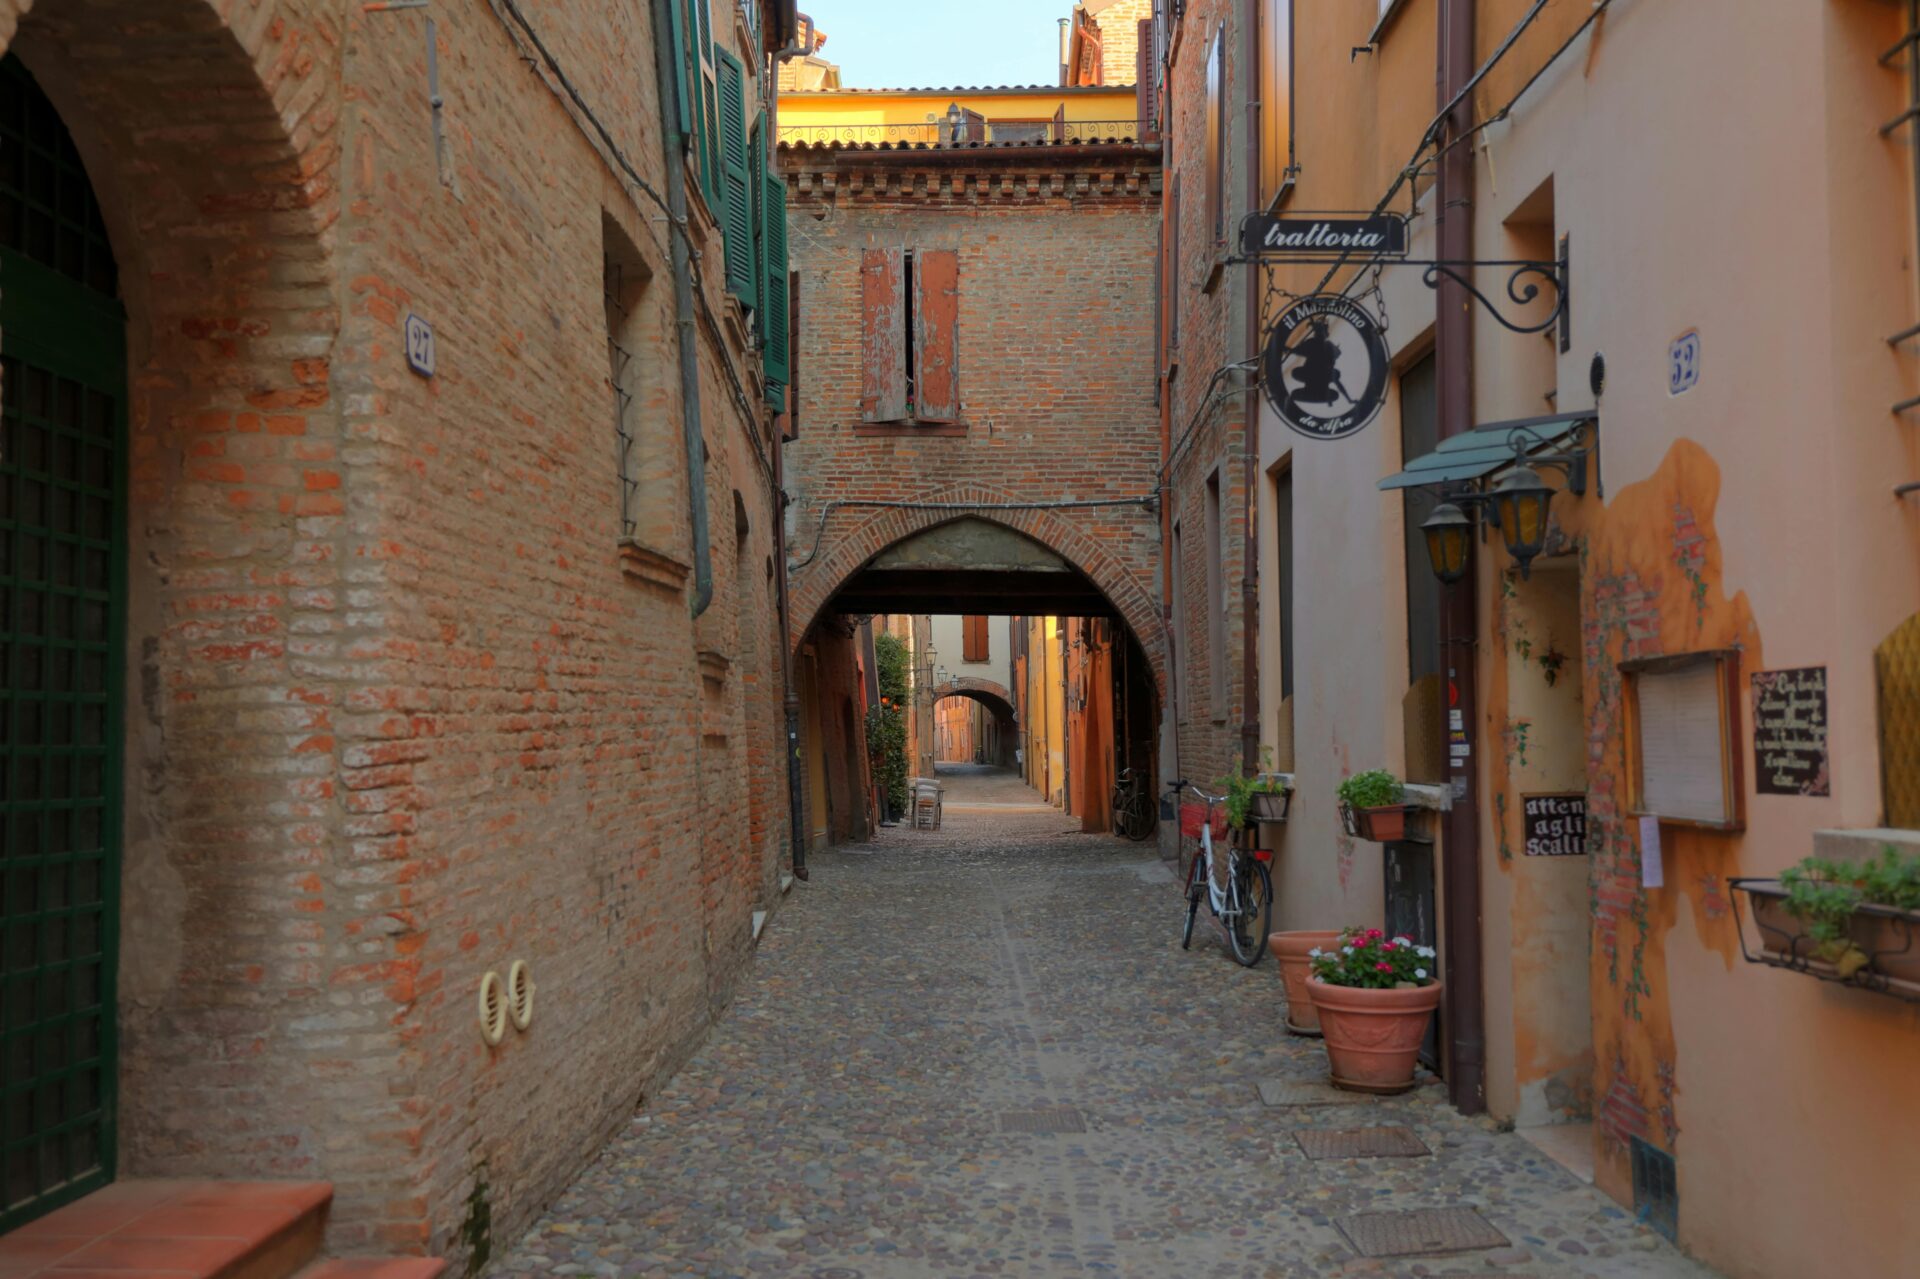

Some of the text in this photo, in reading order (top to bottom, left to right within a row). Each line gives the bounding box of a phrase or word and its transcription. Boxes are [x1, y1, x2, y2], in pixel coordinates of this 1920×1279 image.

[1264, 223, 1386, 248] trattoria
[1282, 314, 1297, 330] il
[413, 325, 429, 365] 27
[1298, 415, 1354, 434] da Afra
[1535, 816, 1583, 837] agli
